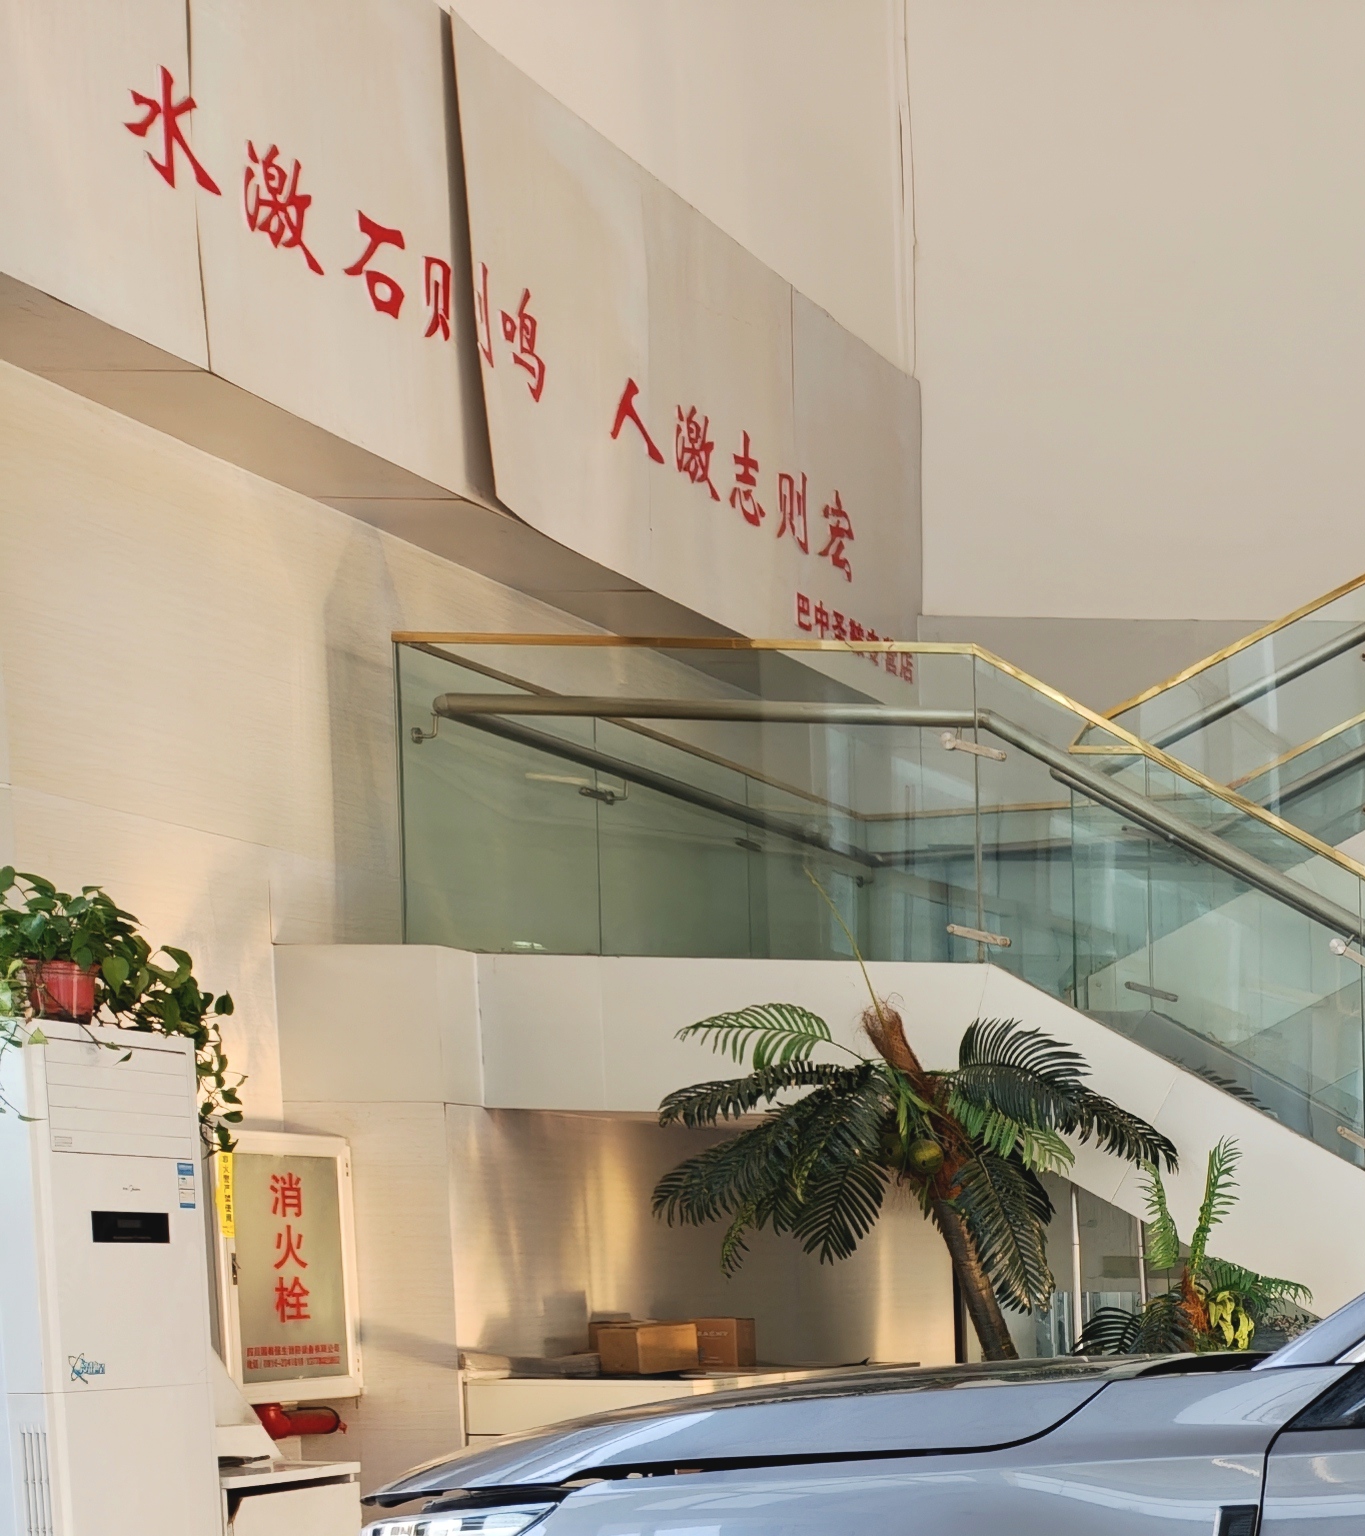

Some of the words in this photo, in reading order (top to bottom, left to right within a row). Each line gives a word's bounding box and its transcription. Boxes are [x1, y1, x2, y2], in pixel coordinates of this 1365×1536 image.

[123, 64, 548, 402] 水激石则鸣
[610, 377, 856, 583] 人激志则宏
[269, 1171, 312, 1324] 消火栓
